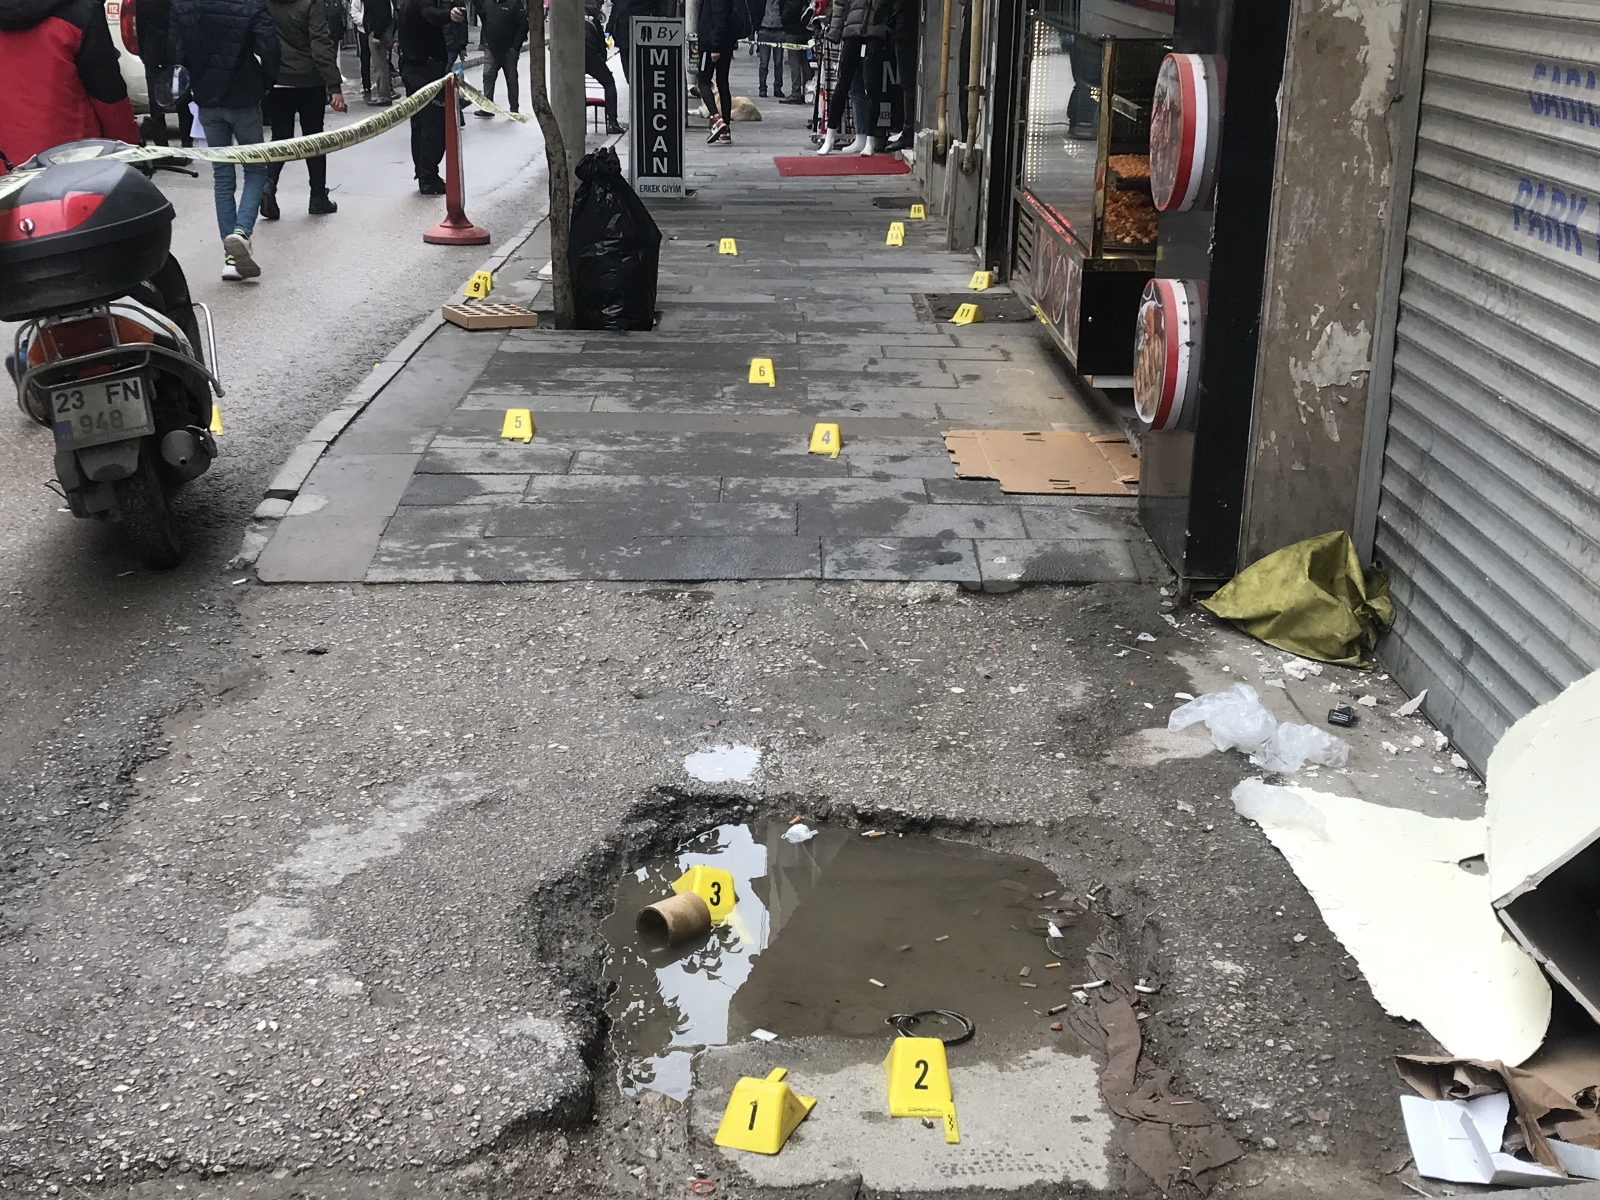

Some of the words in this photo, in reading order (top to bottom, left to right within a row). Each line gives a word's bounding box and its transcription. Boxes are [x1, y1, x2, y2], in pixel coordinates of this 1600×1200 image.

[657, 26, 679, 42] By
[650, 48, 669, 174] MERCAN
[639, 184, 660, 193] ERKEK
[913, 206, 922, 214] 16
[1513, 178, 1588, 257] PARK
[890, 233, 899, 241] 14
[723, 241, 732, 250] 13
[473, 282, 480, 292] 9
[974, 275, 986, 285] 12
[959, 308, 971, 318] 11
[758, 365, 766, 377] 6
[55, 390, 85, 413] 23
[105, 380, 141, 404] FN
[514, 415, 522, 429] 5
[821, 430, 831, 445] 4
[709, 881, 722, 907] 3
[913, 1059, 929, 1091] 2
[748, 1099, 759, 1131] 1
